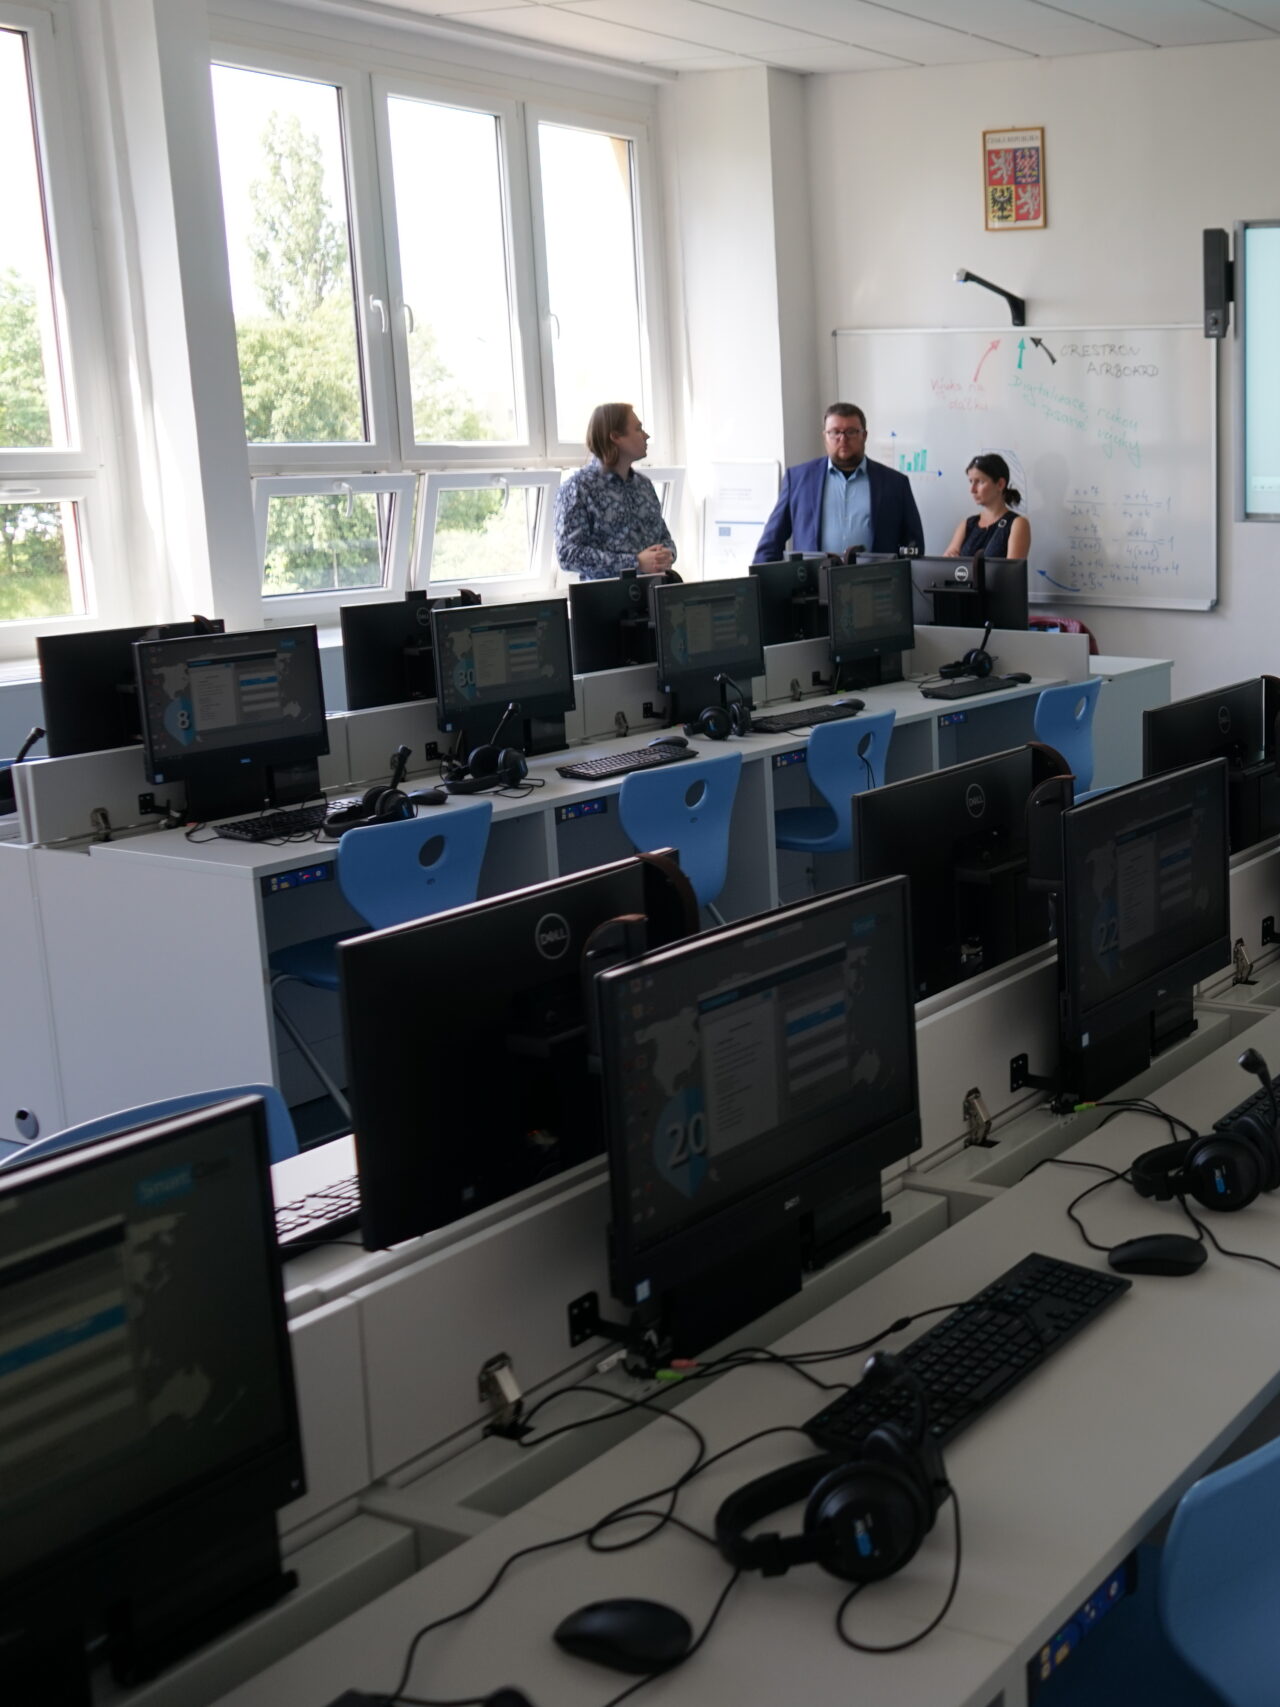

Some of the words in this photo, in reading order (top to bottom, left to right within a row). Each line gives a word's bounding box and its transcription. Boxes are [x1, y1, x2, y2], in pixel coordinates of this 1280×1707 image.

[1060, 343, 1141, 358] CRESTRON
[1086, 361, 1159, 378] AIRBOARD
[459, 668, 475, 688] 30
[177, 710, 189, 729] 8
[540, 928, 568, 946] DELL
[665, 1112, 706, 1168] 20
